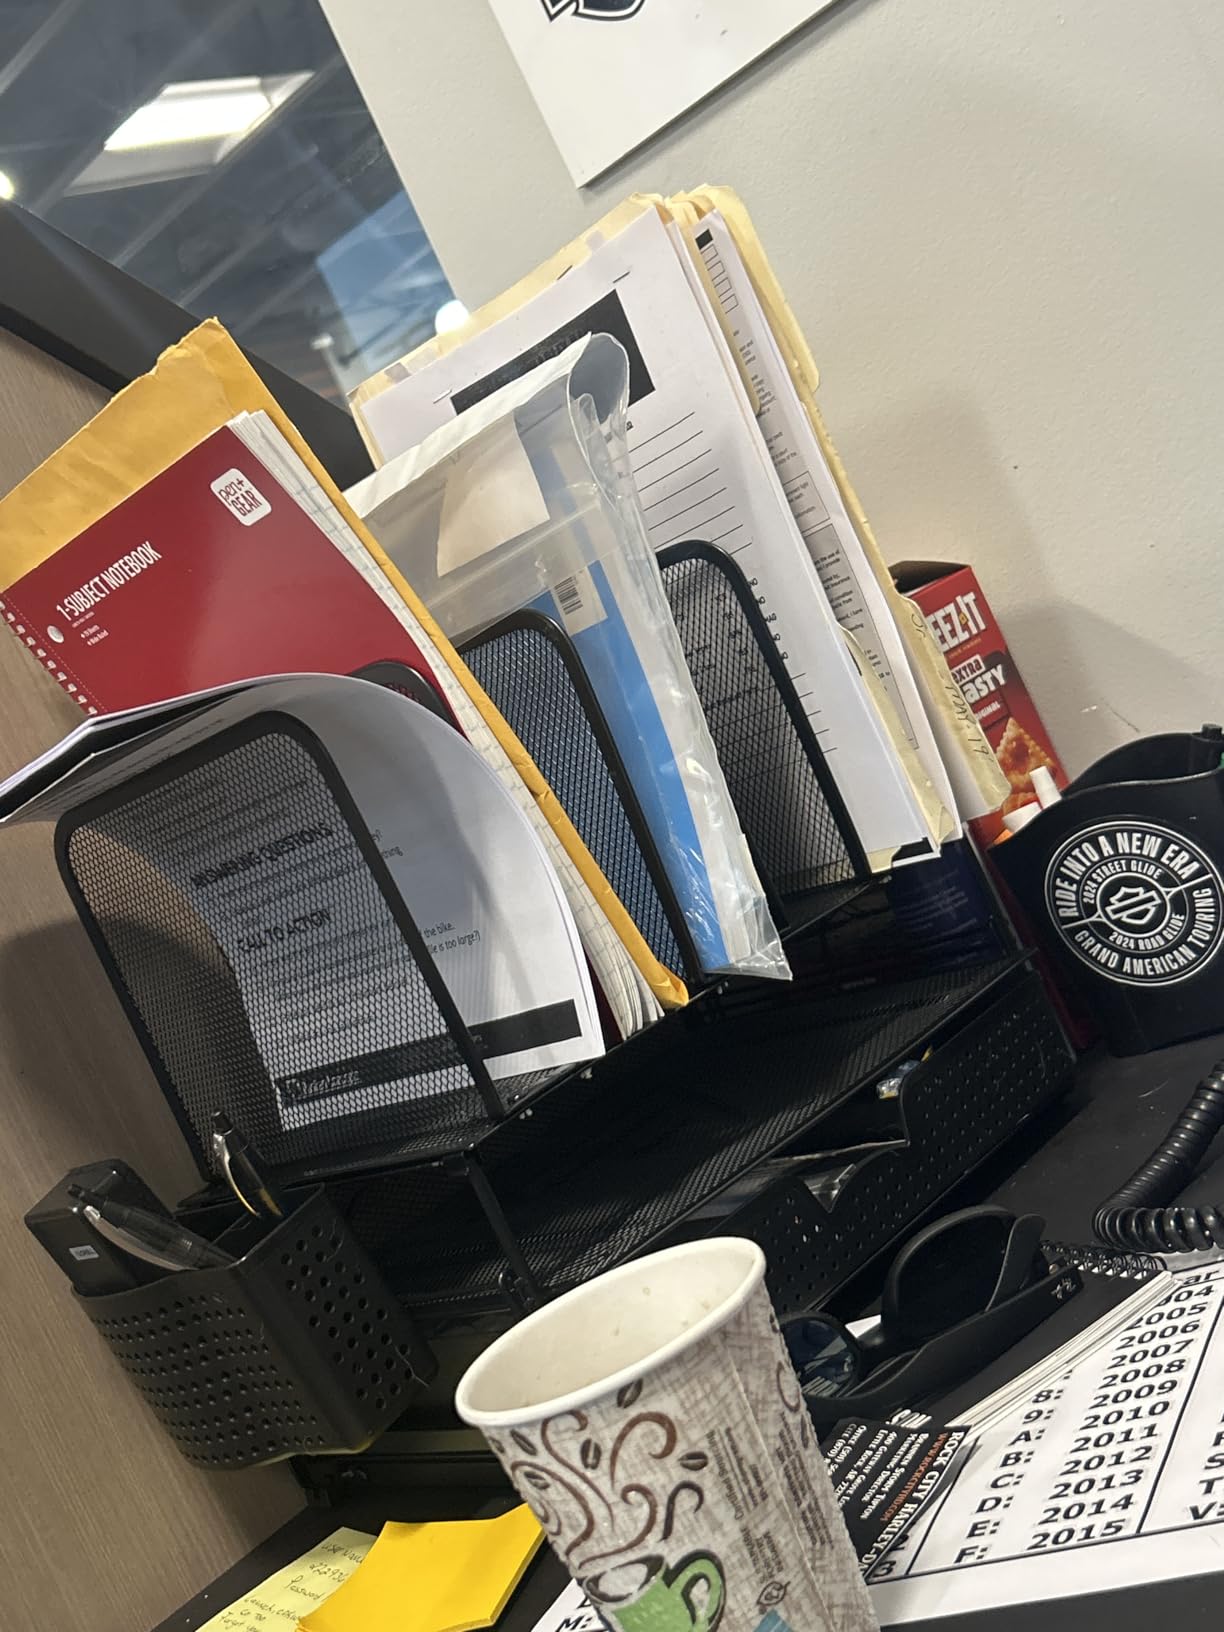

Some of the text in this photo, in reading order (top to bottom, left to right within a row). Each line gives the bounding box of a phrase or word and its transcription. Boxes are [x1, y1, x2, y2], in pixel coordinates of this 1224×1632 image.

[231, 490, 263, 516] GEAR
[56, 540, 162, 621] 1-SUBJECT NOTEBOOK
[1055, 832, 1200, 917] RIDE INTO A NEW ERA
[1083, 859, 1163, 905] 2024 STREET GLIDE
[264, 925, 285, 945] TO
[286, 907, 332, 935] ACTION
[424, 927, 436, 937] the
[1074, 887, 1217, 976] GRAND AMERICAN TOURING
[1108, 912, 1186, 951] 2024 ROAD GLIDE
[1183, 1269, 1220, 1285] ar
[1107, 1338, 1195, 1370] 2007
[1115, 1319, 1201, 1351] 2006
[1022, 1379, 1178, 1425] 9: 2009
[1032, 1388, 1064, 1404] 8:
[1097, 1358, 1187, 1390] 2008
[999, 1423, 1159, 1468] B: 2011
[1008, 1400, 1170, 1446] A: 2010
[932, 1431, 965, 1466] ROCK
[990, 1473, 1024, 1490] C:
[1059, 1445, 1153, 1476] 2012
[912, 1471, 940, 1500] CITY
[975, 1495, 1014, 1514] D:
[1049, 1468, 1144, 1500] 2013
[859, 1503, 918, 1572] HARLEY-DA
[966, 1520, 1001, 1539] E:
[1038, 1493, 1134, 1525] 2014
[953, 1519, 1126, 1564] F: 2015
